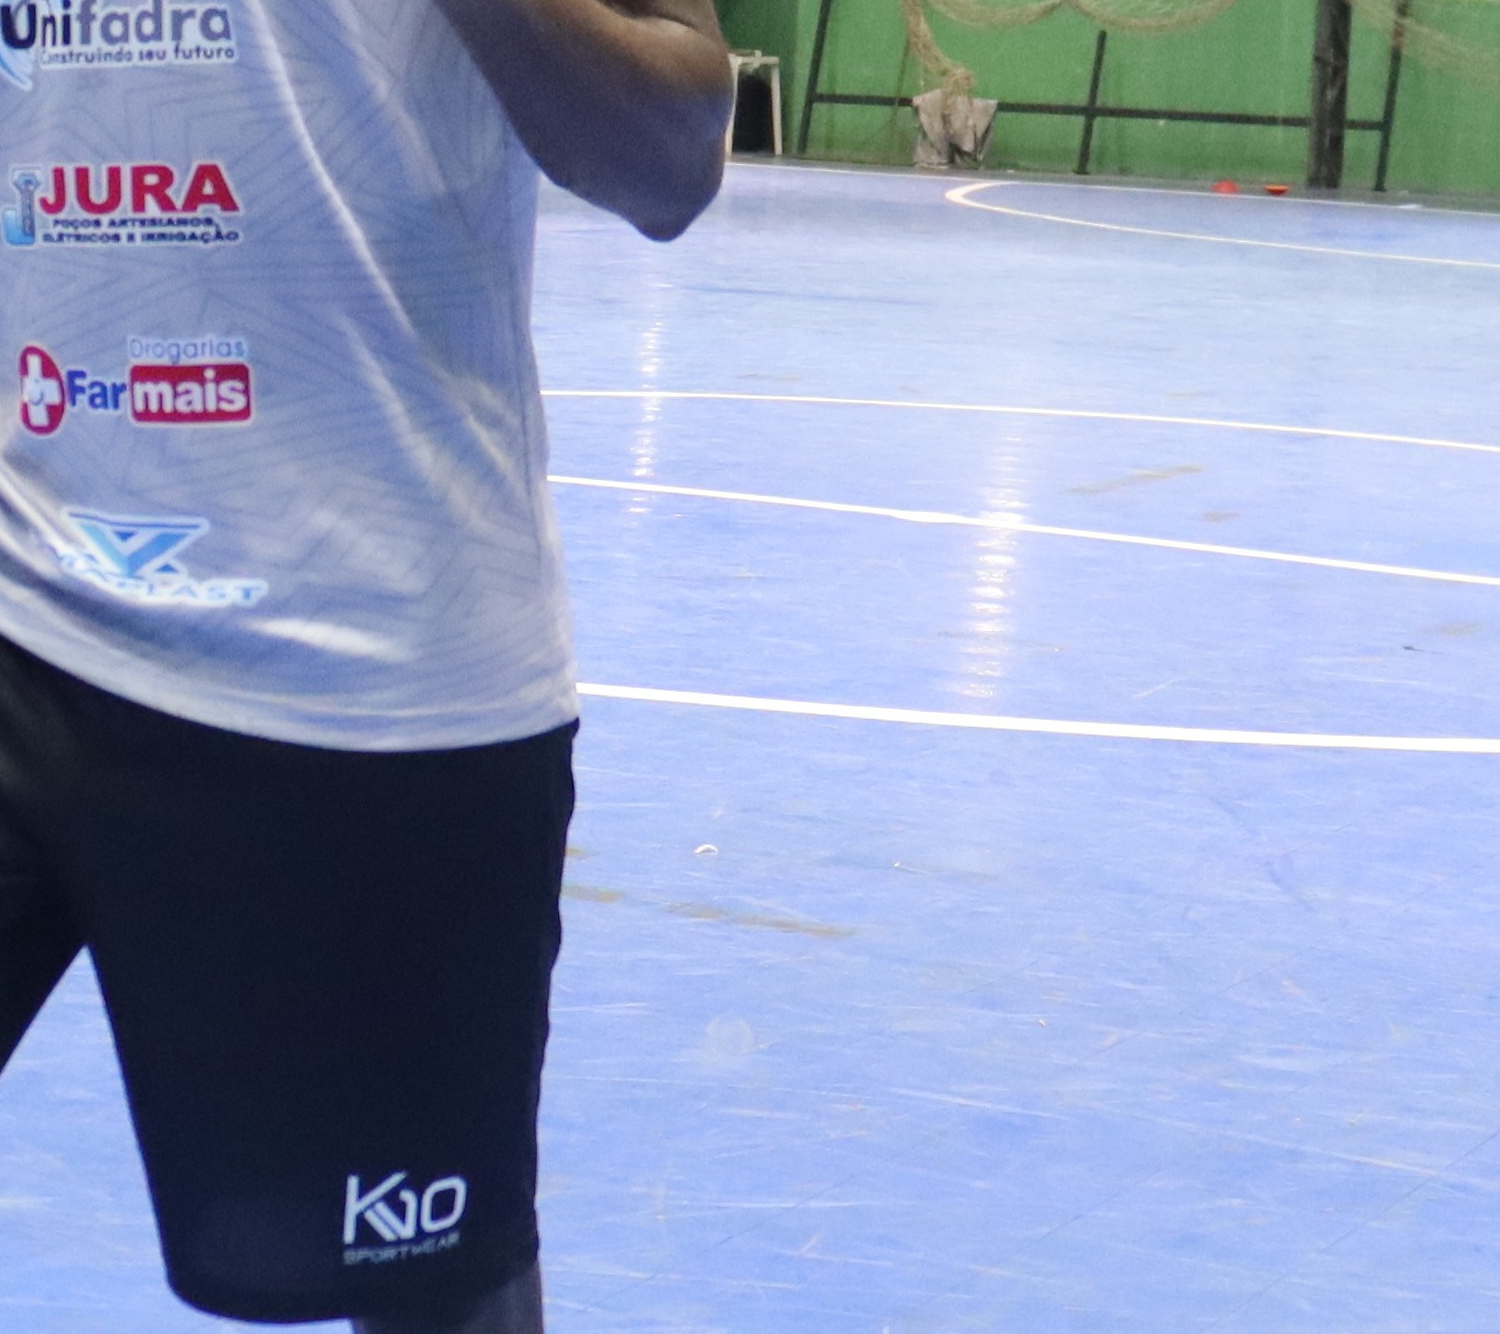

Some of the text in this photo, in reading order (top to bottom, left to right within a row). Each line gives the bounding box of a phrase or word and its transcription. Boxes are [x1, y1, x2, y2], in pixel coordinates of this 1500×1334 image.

[138, 49, 167, 61] seu
[174, 43, 235, 60] futuro
[39, 164, 240, 214] JURA
[129, 339, 245, 364] Drogarias
